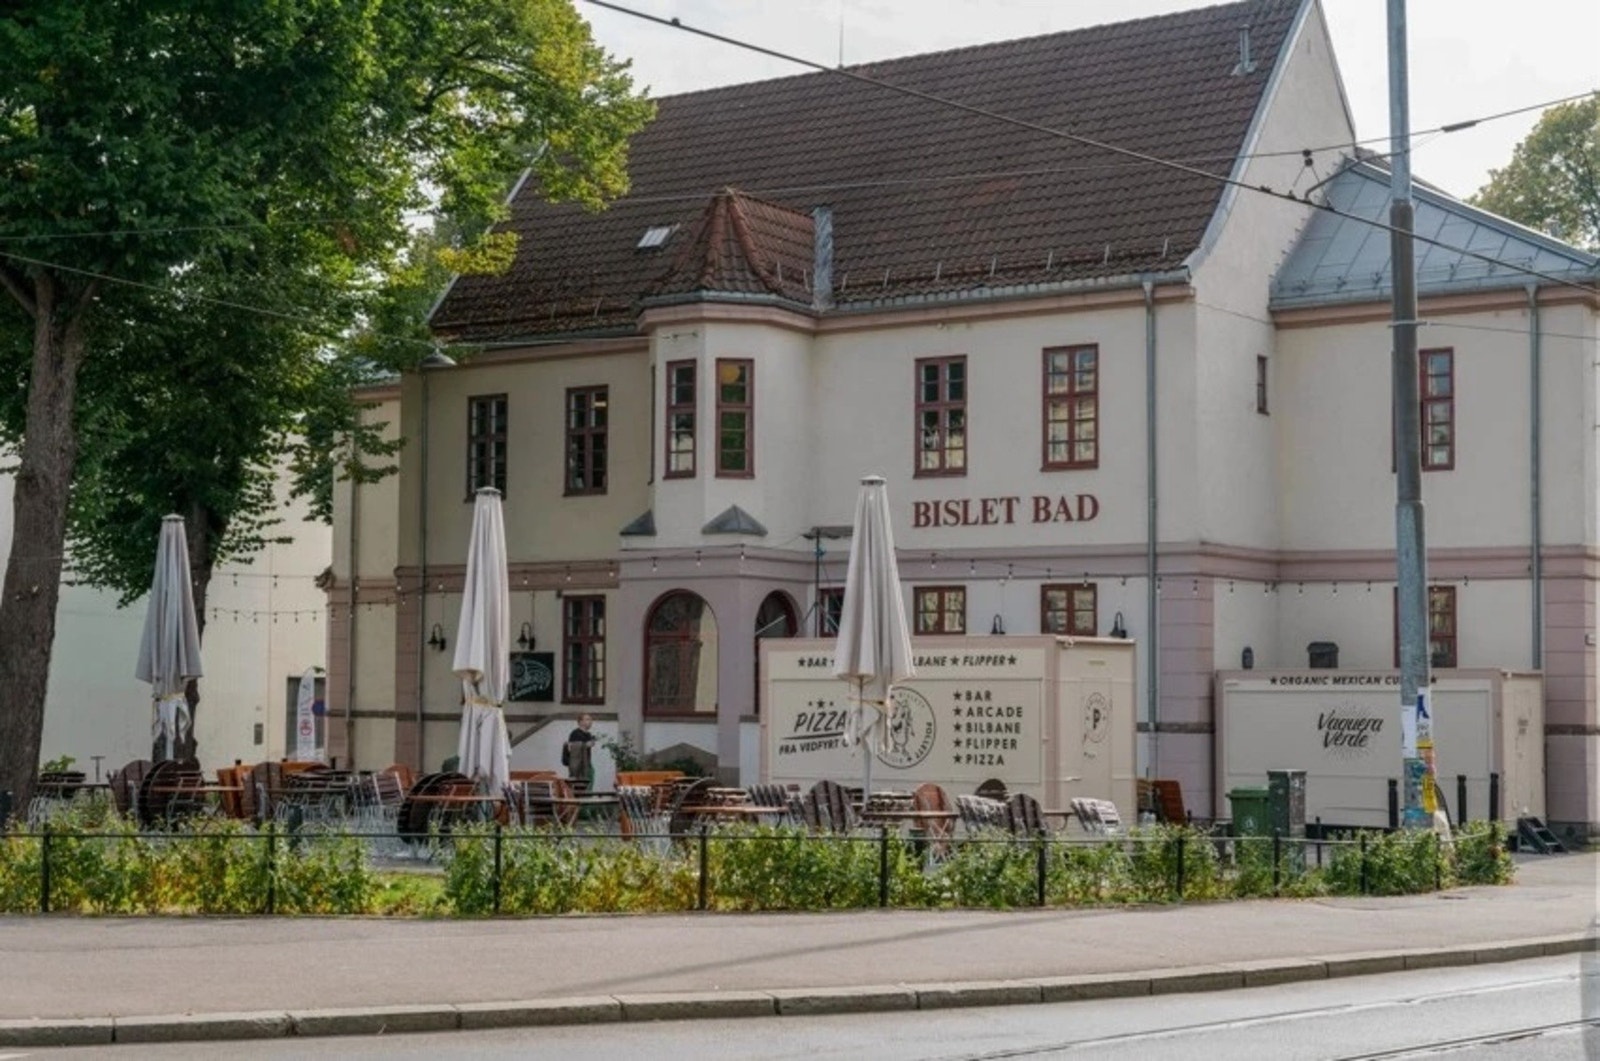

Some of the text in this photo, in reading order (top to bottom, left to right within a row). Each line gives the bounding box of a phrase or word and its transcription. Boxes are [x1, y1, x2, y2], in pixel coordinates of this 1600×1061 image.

[912, 494, 1100, 528] BISLET BAD
[807, 655, 1006, 667] BAR LBANE FLIPPER
[1280, 676, 1328, 685] ORGANIC
[1332, 676, 1380, 685] MEXICAN
[965, 690, 992, 701] BAR
[966, 706, 1023, 718] ARCADE
[794, 710, 847, 732] PIZZA
[1317, 710, 1384, 733] Vaquera
[965, 722, 1021, 734] BILBANE
[965, 738, 1018, 750] FLIPPER
[1323, 731, 1370, 748] Verde
[779, 744, 797, 755] FRA
[965, 754, 1005, 765] PIZZA
